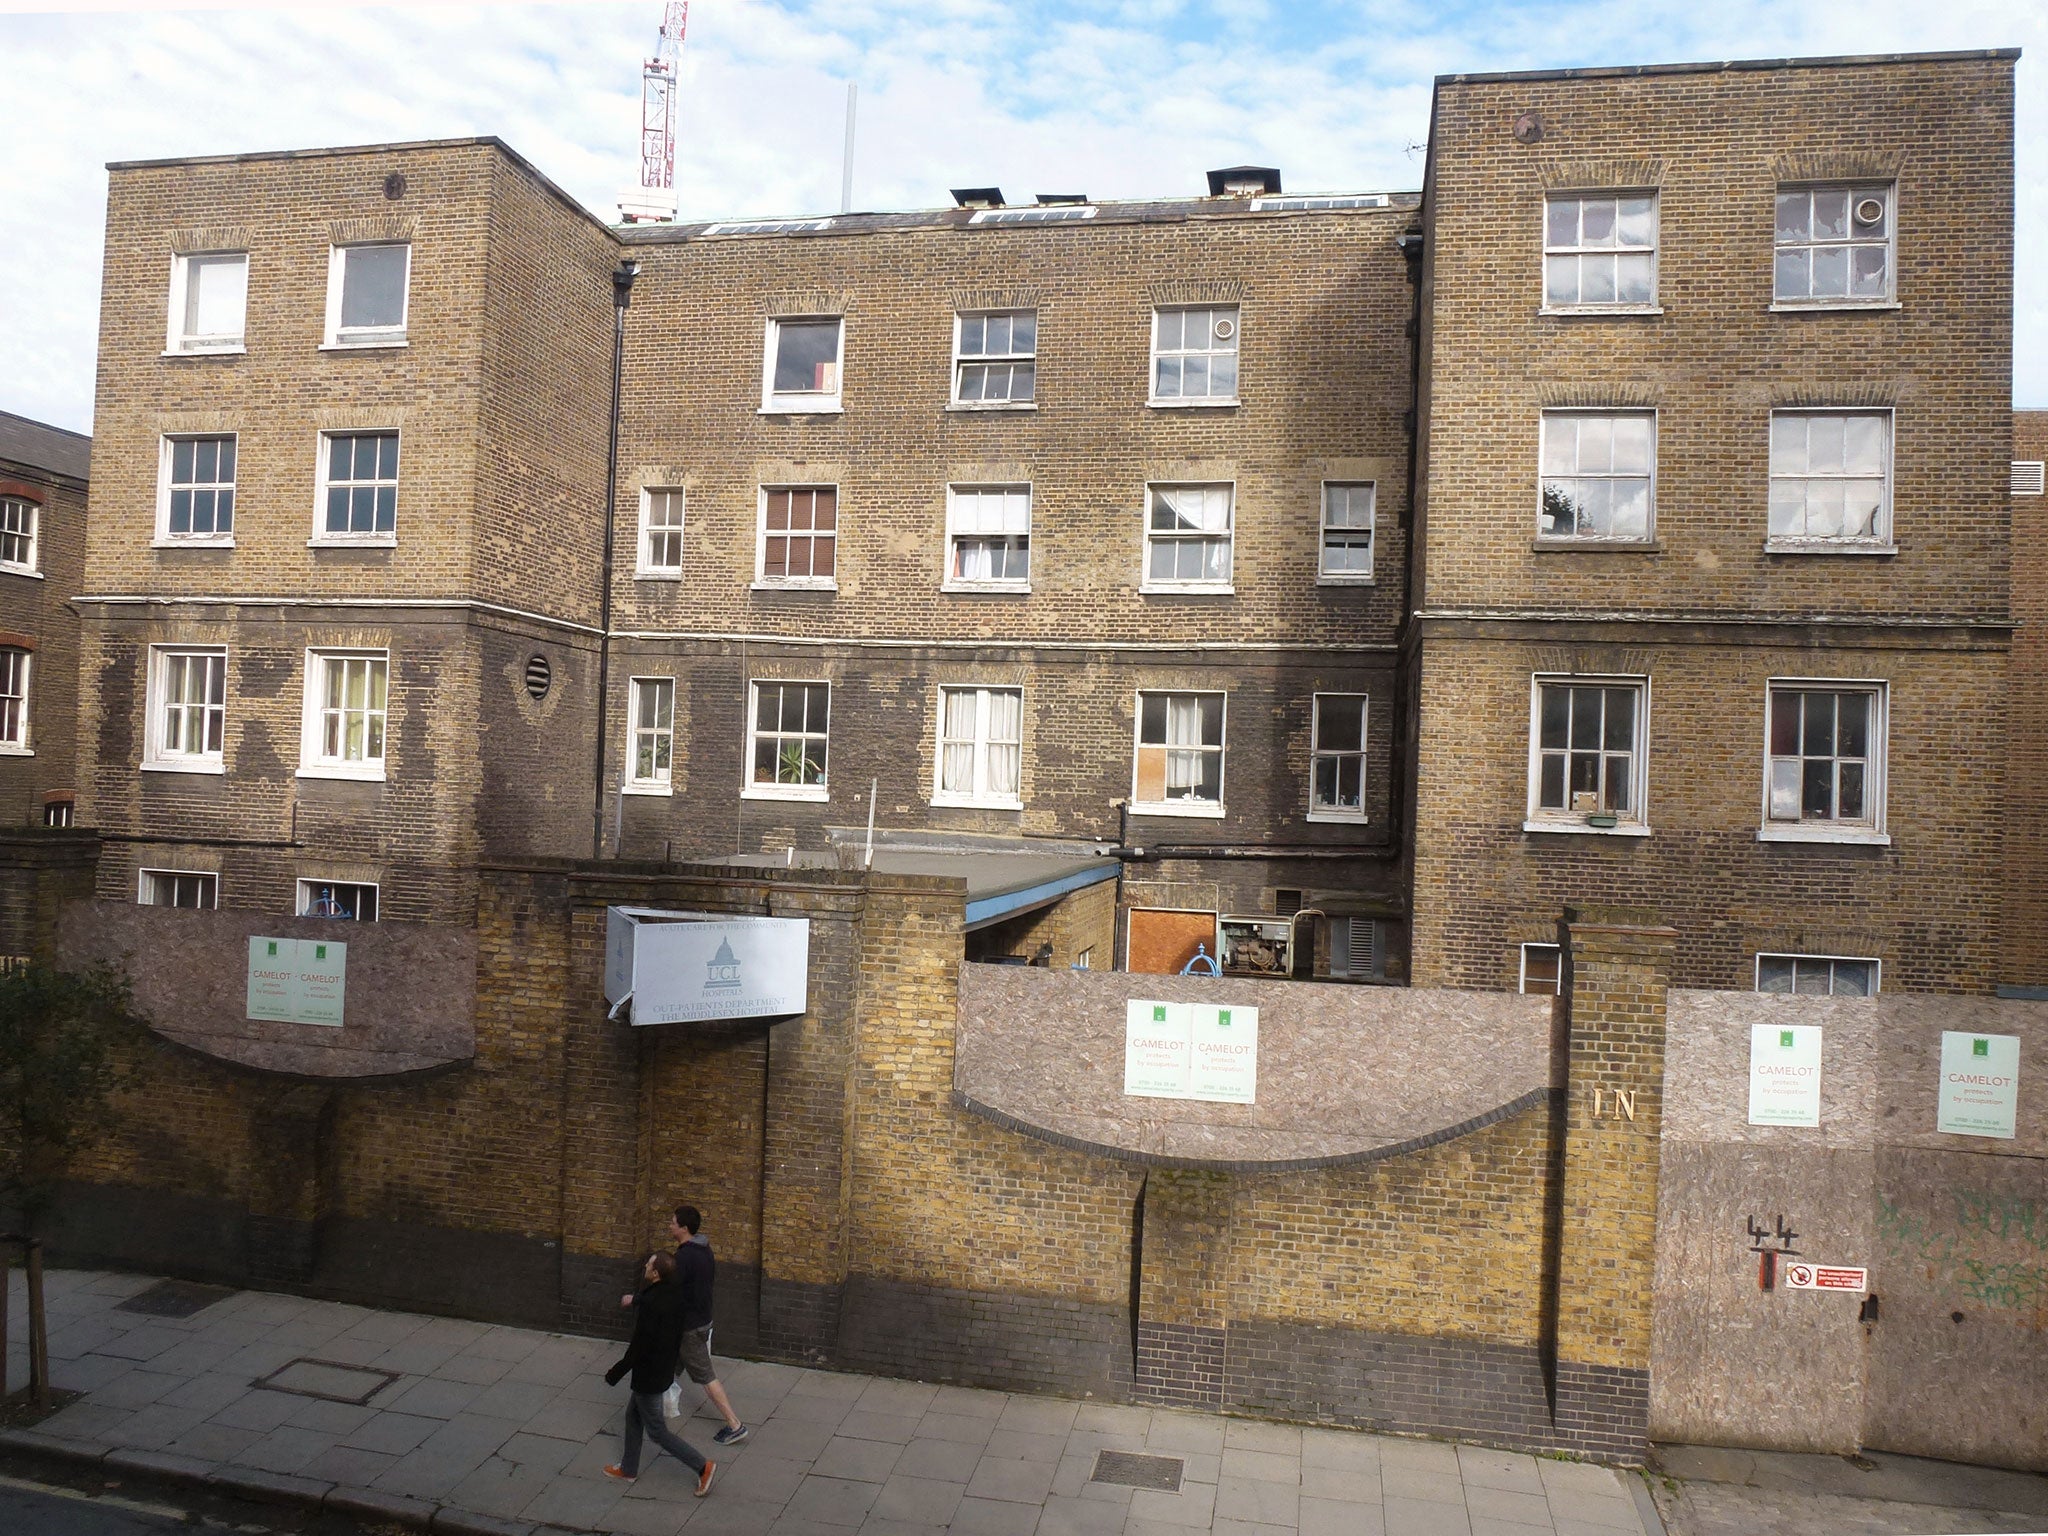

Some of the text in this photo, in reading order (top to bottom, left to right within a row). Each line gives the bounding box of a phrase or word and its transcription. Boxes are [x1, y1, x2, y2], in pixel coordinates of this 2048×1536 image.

[659, 924, 687, 933] ACUTE
[709, 923, 725, 931] FOR
[741, 921, 788, 930] COMMUNITY
[253, 969, 292, 980] CAMELOT
[300, 973, 341, 984] CAMELOT
[707, 966, 741, 980] UCL
[702, 988, 743, 998] HOSPITALS
[652, 997, 786, 1014] OUT-PATIENTS DEPARTMENT
[660, 1006, 780, 1022] THE MIDDLESEX HOSPITAL
[1133, 1038, 1185, 1050] CAMELOT
[1198, 1042, 1250, 1055] CAMELOT
[1758, 1065, 1814, 1077] CAMELOT
[1948, 1073, 2011, 1087] CAMELOT
[1963, 1088, 1993, 1096] protects
[1592, 1088, 1637, 1121] IN
[1963, 1097, 2003, 1106] occupation
[1747, 1214, 1800, 1248] 44
